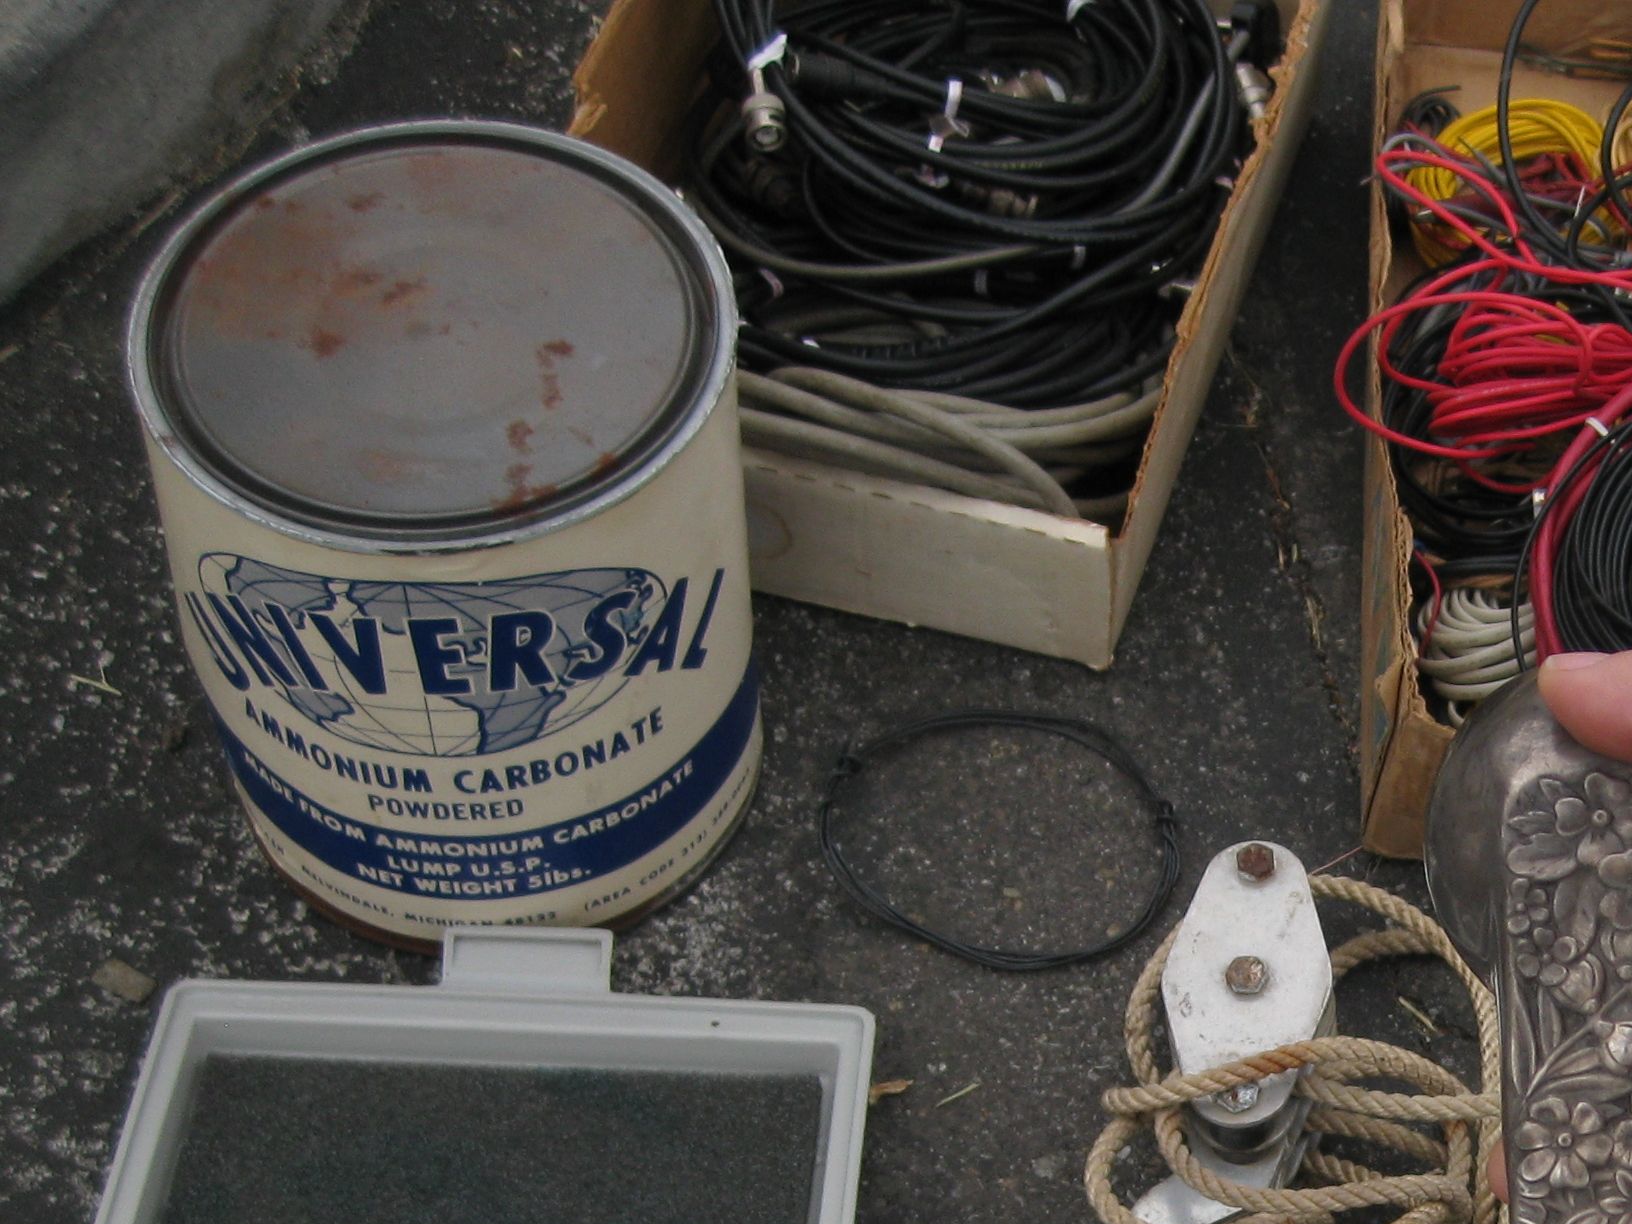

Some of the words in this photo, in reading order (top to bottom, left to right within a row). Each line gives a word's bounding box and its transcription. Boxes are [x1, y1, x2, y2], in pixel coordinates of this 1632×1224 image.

[184, 568, 725, 695] UNIVERSAL
[246, 697, 433, 793] AMMONIUM
[453, 706, 664, 794] CARBONATE
[244, 752, 294, 801] MADE
[300, 799, 367, 842] FROM
[376, 833, 544, 857] AMMONIUM
[553, 760, 694, 844] CARBONATE
[367, 793, 524, 821] POWDERED
[357, 862, 404, 888] NET
[414, 877, 517, 895] WEIGHT
[528, 866, 592, 889] 5lbs.
[387, 855, 461, 877] LUMP
[471, 856, 550, 877] U.S.P.
